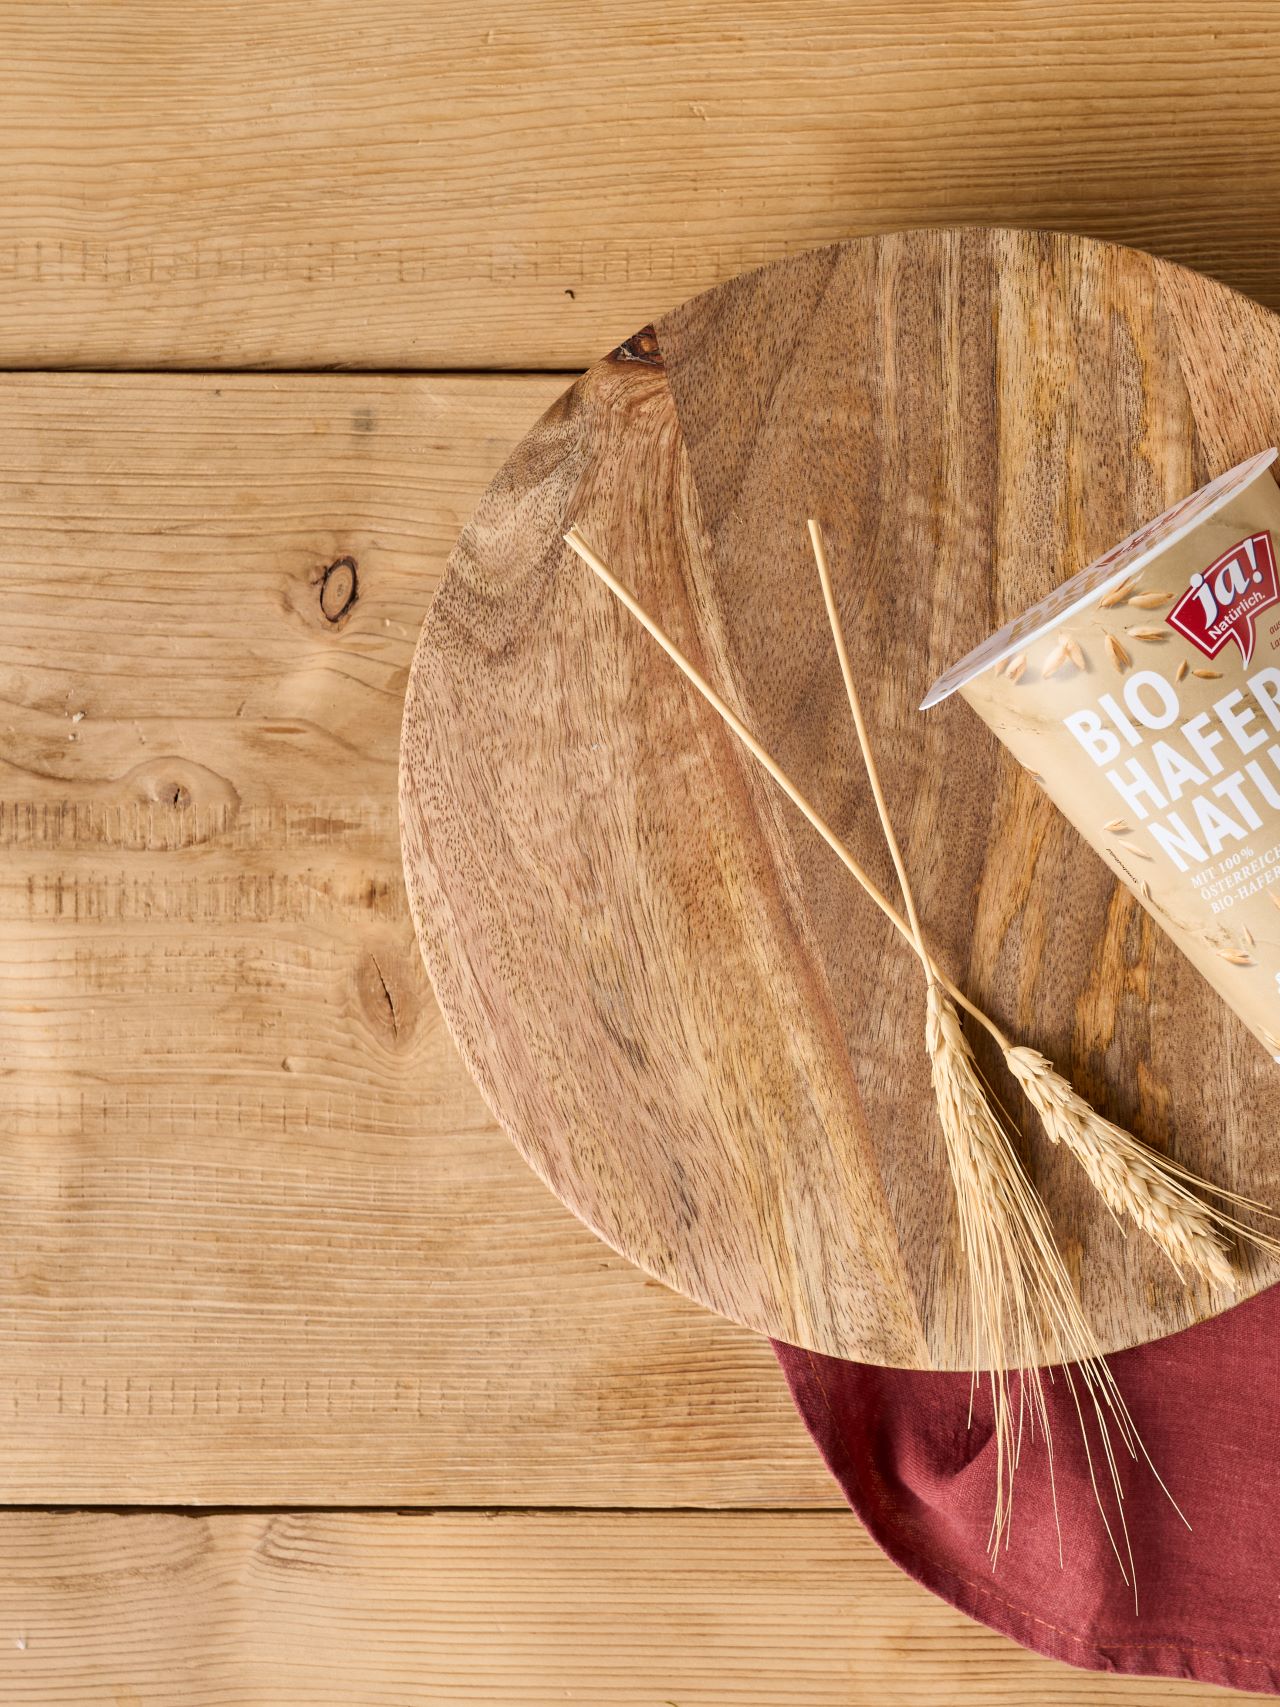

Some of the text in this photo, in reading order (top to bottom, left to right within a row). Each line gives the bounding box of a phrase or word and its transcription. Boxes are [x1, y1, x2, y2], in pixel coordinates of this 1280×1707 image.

[1190, 538, 1263, 630] ja!
[1208, 591, 1266, 640] Natürlich.
[1063, 670, 1180, 767] BIO
[1191, 866, 1216, 889] MIT
